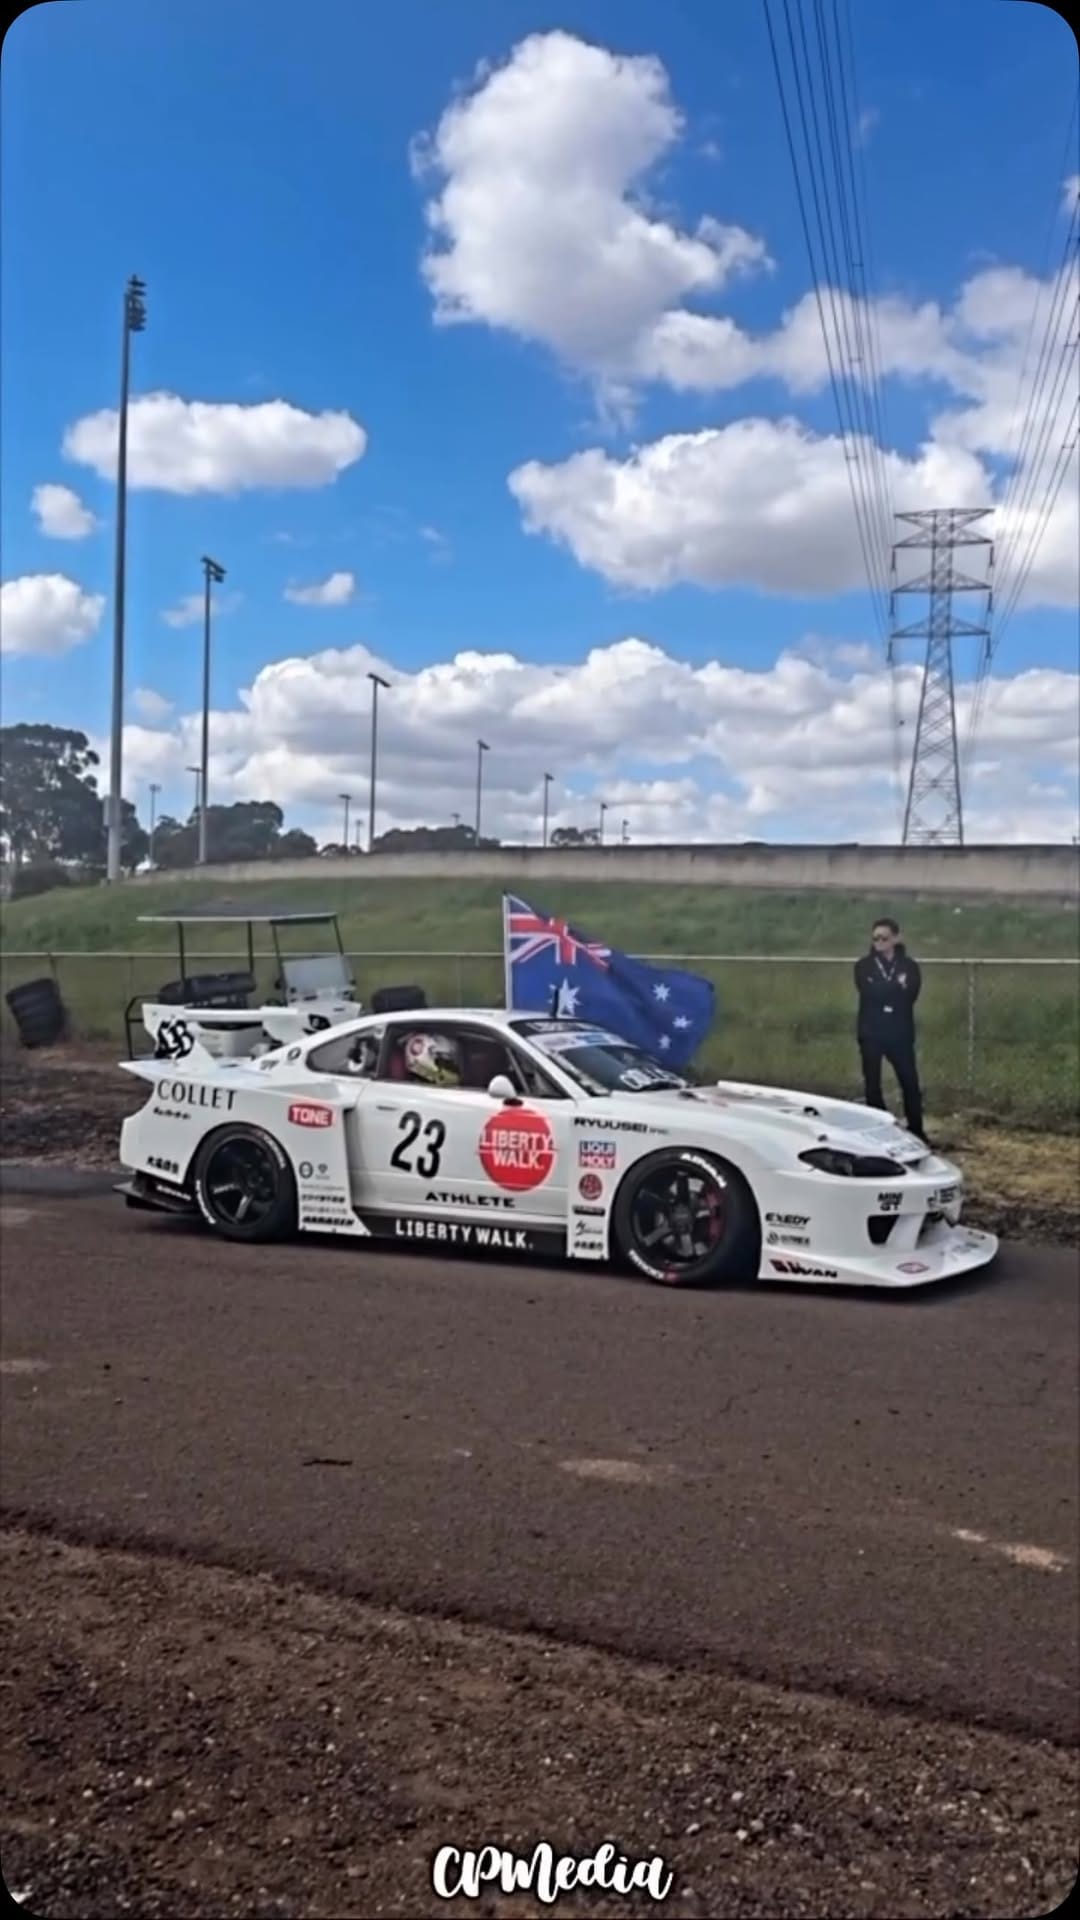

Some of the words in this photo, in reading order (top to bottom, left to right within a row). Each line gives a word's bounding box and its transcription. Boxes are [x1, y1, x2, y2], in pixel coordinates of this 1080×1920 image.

[157, 1079, 238, 1111] COLLET
[291, 1107, 330, 1125] TONE
[574, 1117, 648, 1134] RYUUSEI
[390, 1110, 446, 1179] 23
[482, 1129, 554, 1152] LIBERTY
[425, 1191, 516, 1208] ATHLETE
[765, 1212, 811, 1227] EXEDY
[395, 1219, 474, 1243] LIBERTY
